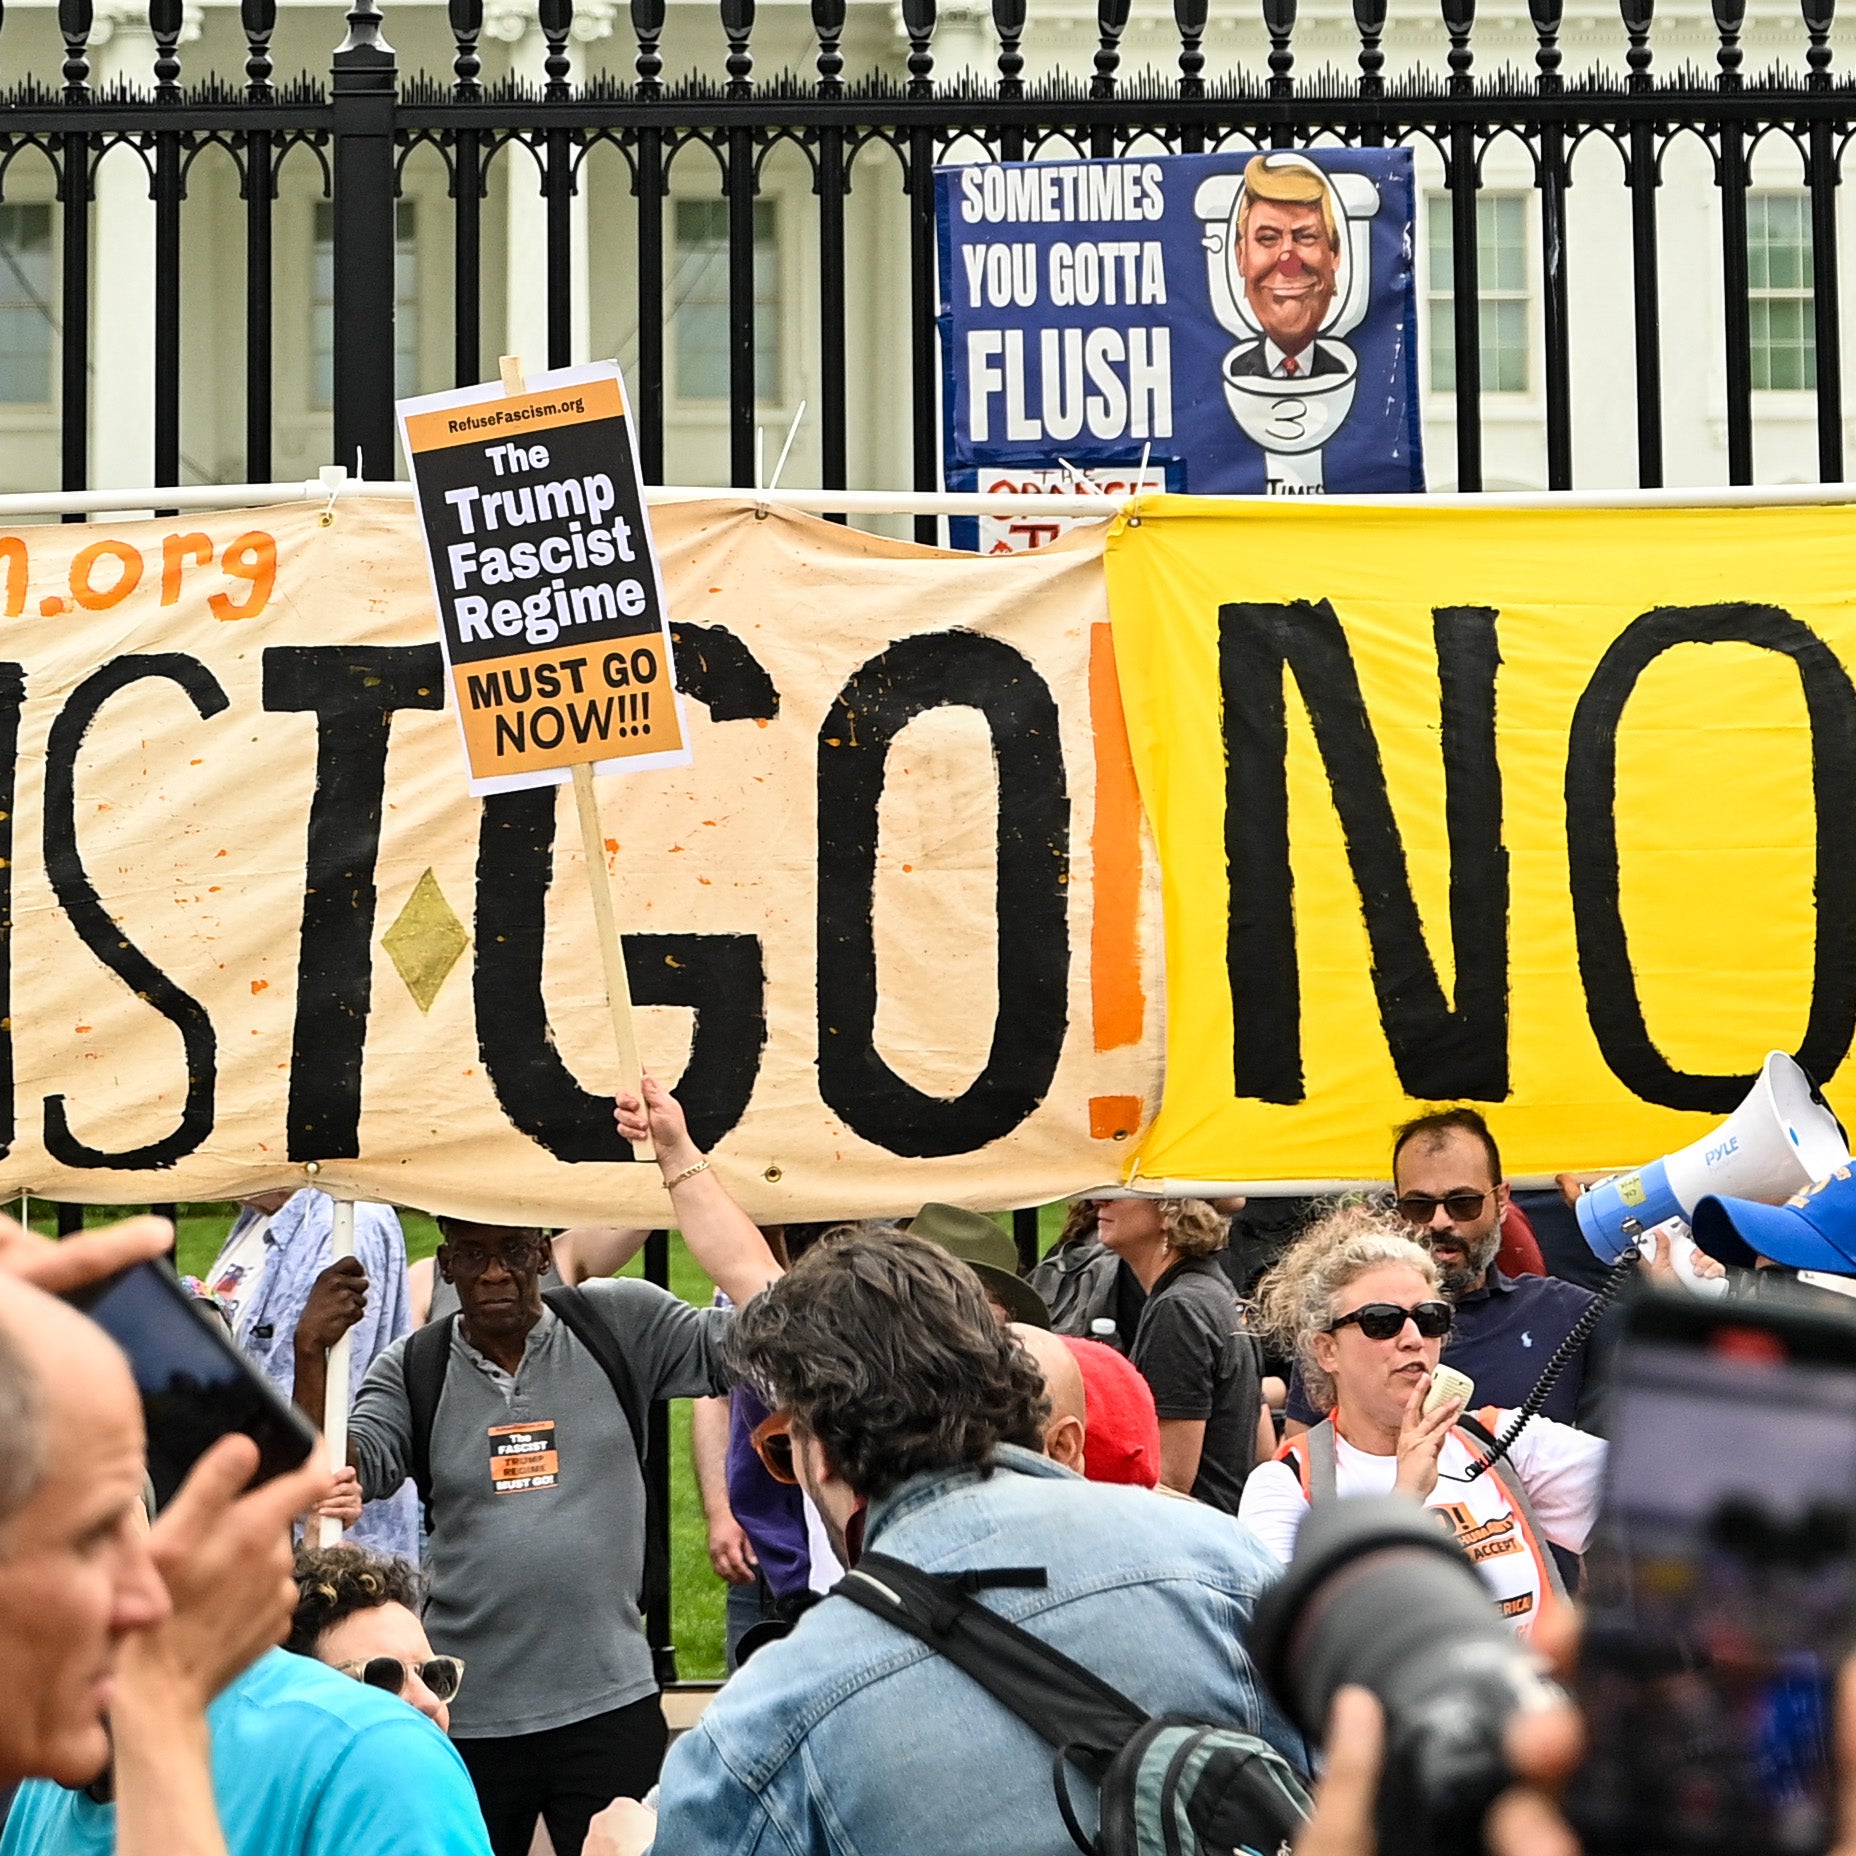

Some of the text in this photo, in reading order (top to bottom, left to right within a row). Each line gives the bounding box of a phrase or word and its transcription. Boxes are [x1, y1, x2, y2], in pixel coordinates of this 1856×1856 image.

[960, 163, 1164, 224] SOMETIMES
[962, 240, 1167, 308] YOU GOTTA
[968, 326, 1173, 442] FLUSH
[447, 397, 585, 435] RefuseFascism.org
[1265, 398, 1307, 440] 3
[485, 443, 551, 477] The
[444, 472, 616, 535] Trump
[447, 516, 636, 590] Fascist
[453, 579, 646, 645] Regime
[467, 647, 658, 711] MUST GO
[495, 691, 652, 757] NOW!!!
[1704, 1136, 1741, 1166] PYLE
[497, 1440, 548, 1455] FASCIST
[508, 1433, 532, 1444] The
[503, 1465, 546, 1476] REGIME
[505, 1455, 545, 1467] TRUMP
[496, 1475, 555, 1491] MUST GO!
[1473, 1537, 1517, 1561] ACCEPT
